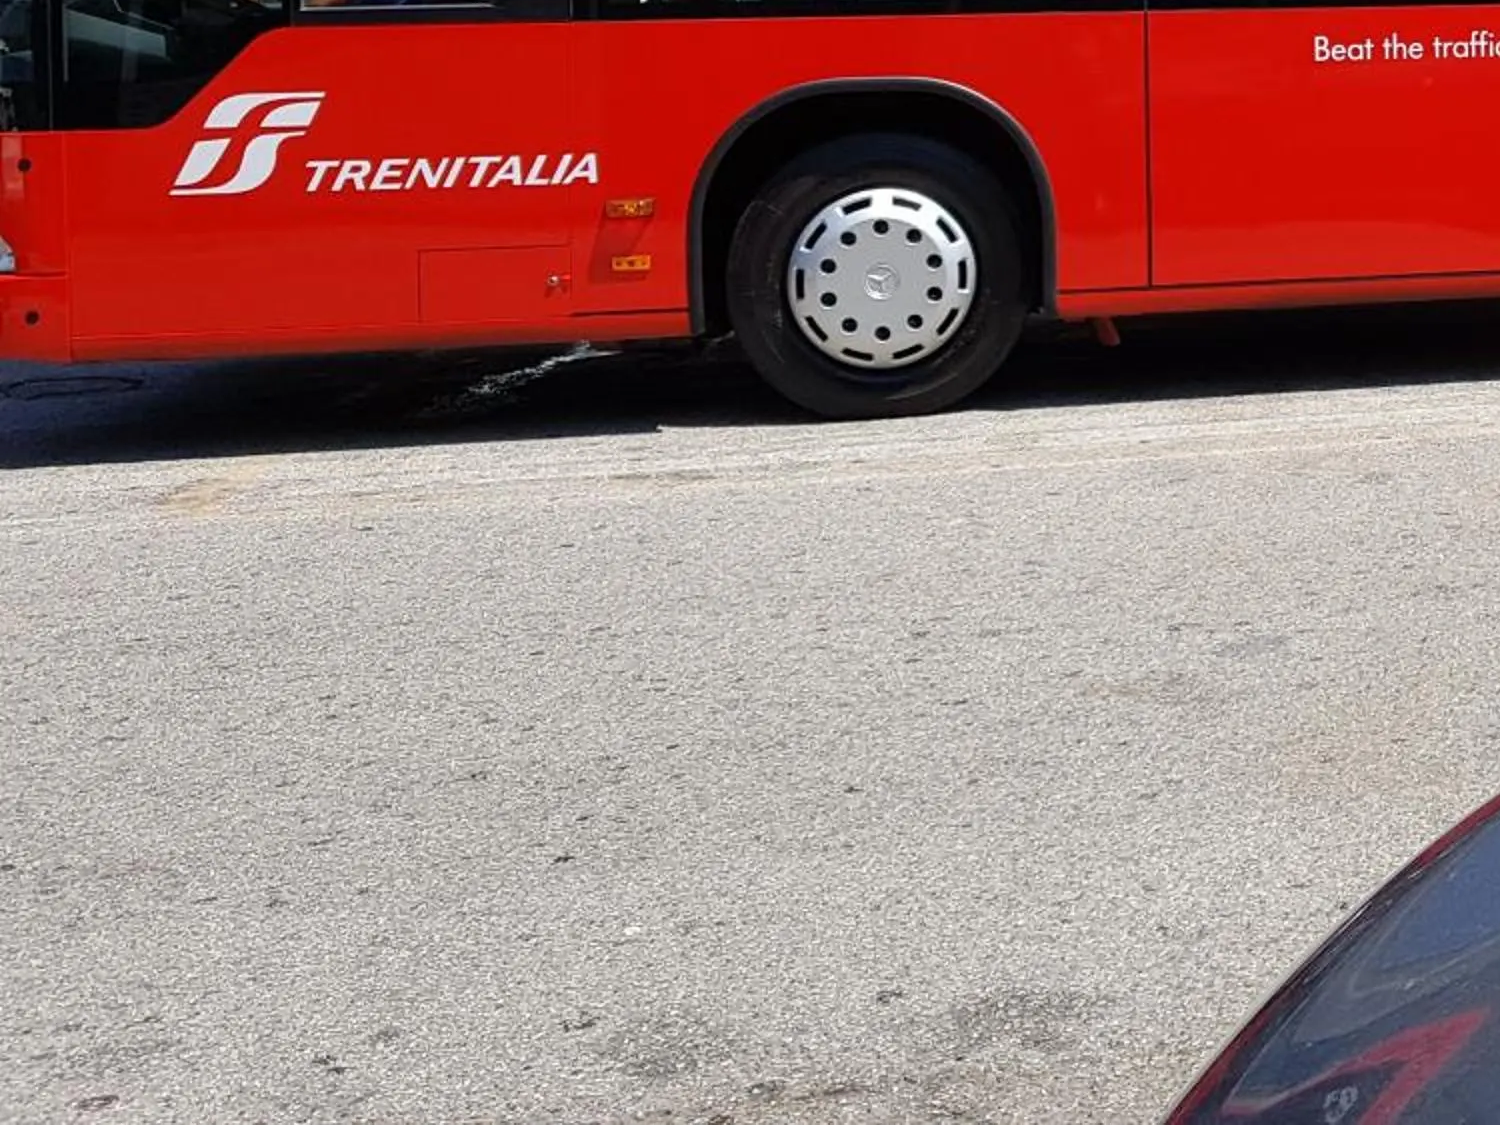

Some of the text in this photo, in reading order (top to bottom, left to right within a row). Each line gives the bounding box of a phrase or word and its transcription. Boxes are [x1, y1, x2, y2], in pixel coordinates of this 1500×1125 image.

[1313, 35, 1375, 62] Beat
[1382, 32, 1425, 60] the
[305, 152, 600, 192] TRENITALIA
